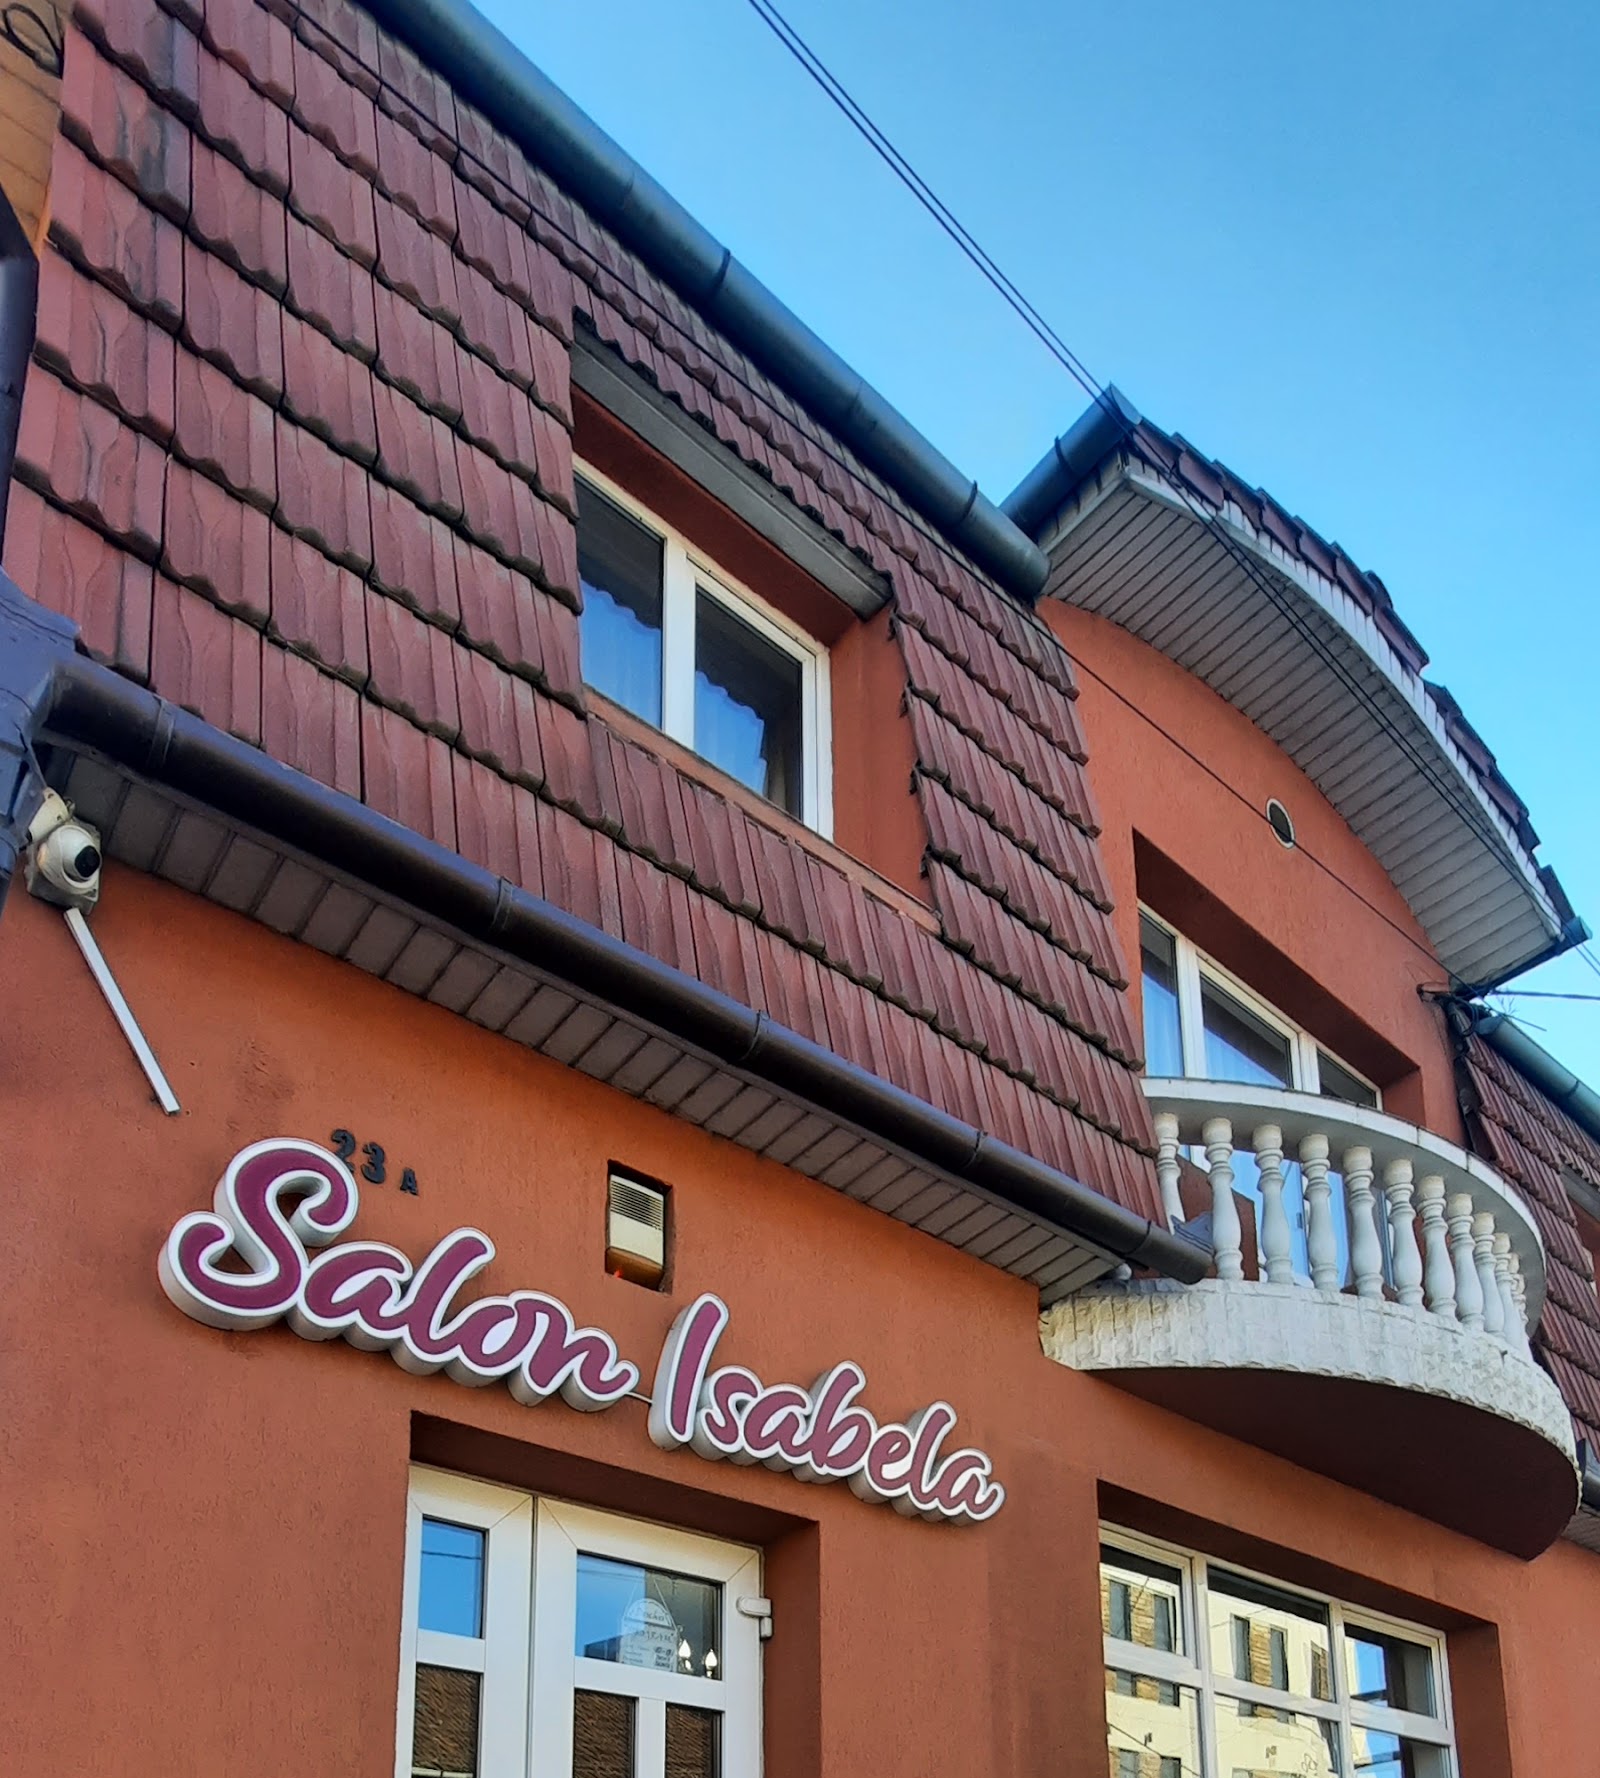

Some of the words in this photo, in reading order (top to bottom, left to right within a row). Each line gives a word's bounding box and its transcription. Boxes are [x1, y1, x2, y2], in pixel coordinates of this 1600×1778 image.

[331, 1128, 385, 1184] 23
[399, 1167, 418, 1196] A
[162, 1138, 639, 1408] Salon
[652, 1294, 1005, 1524] Isabela
